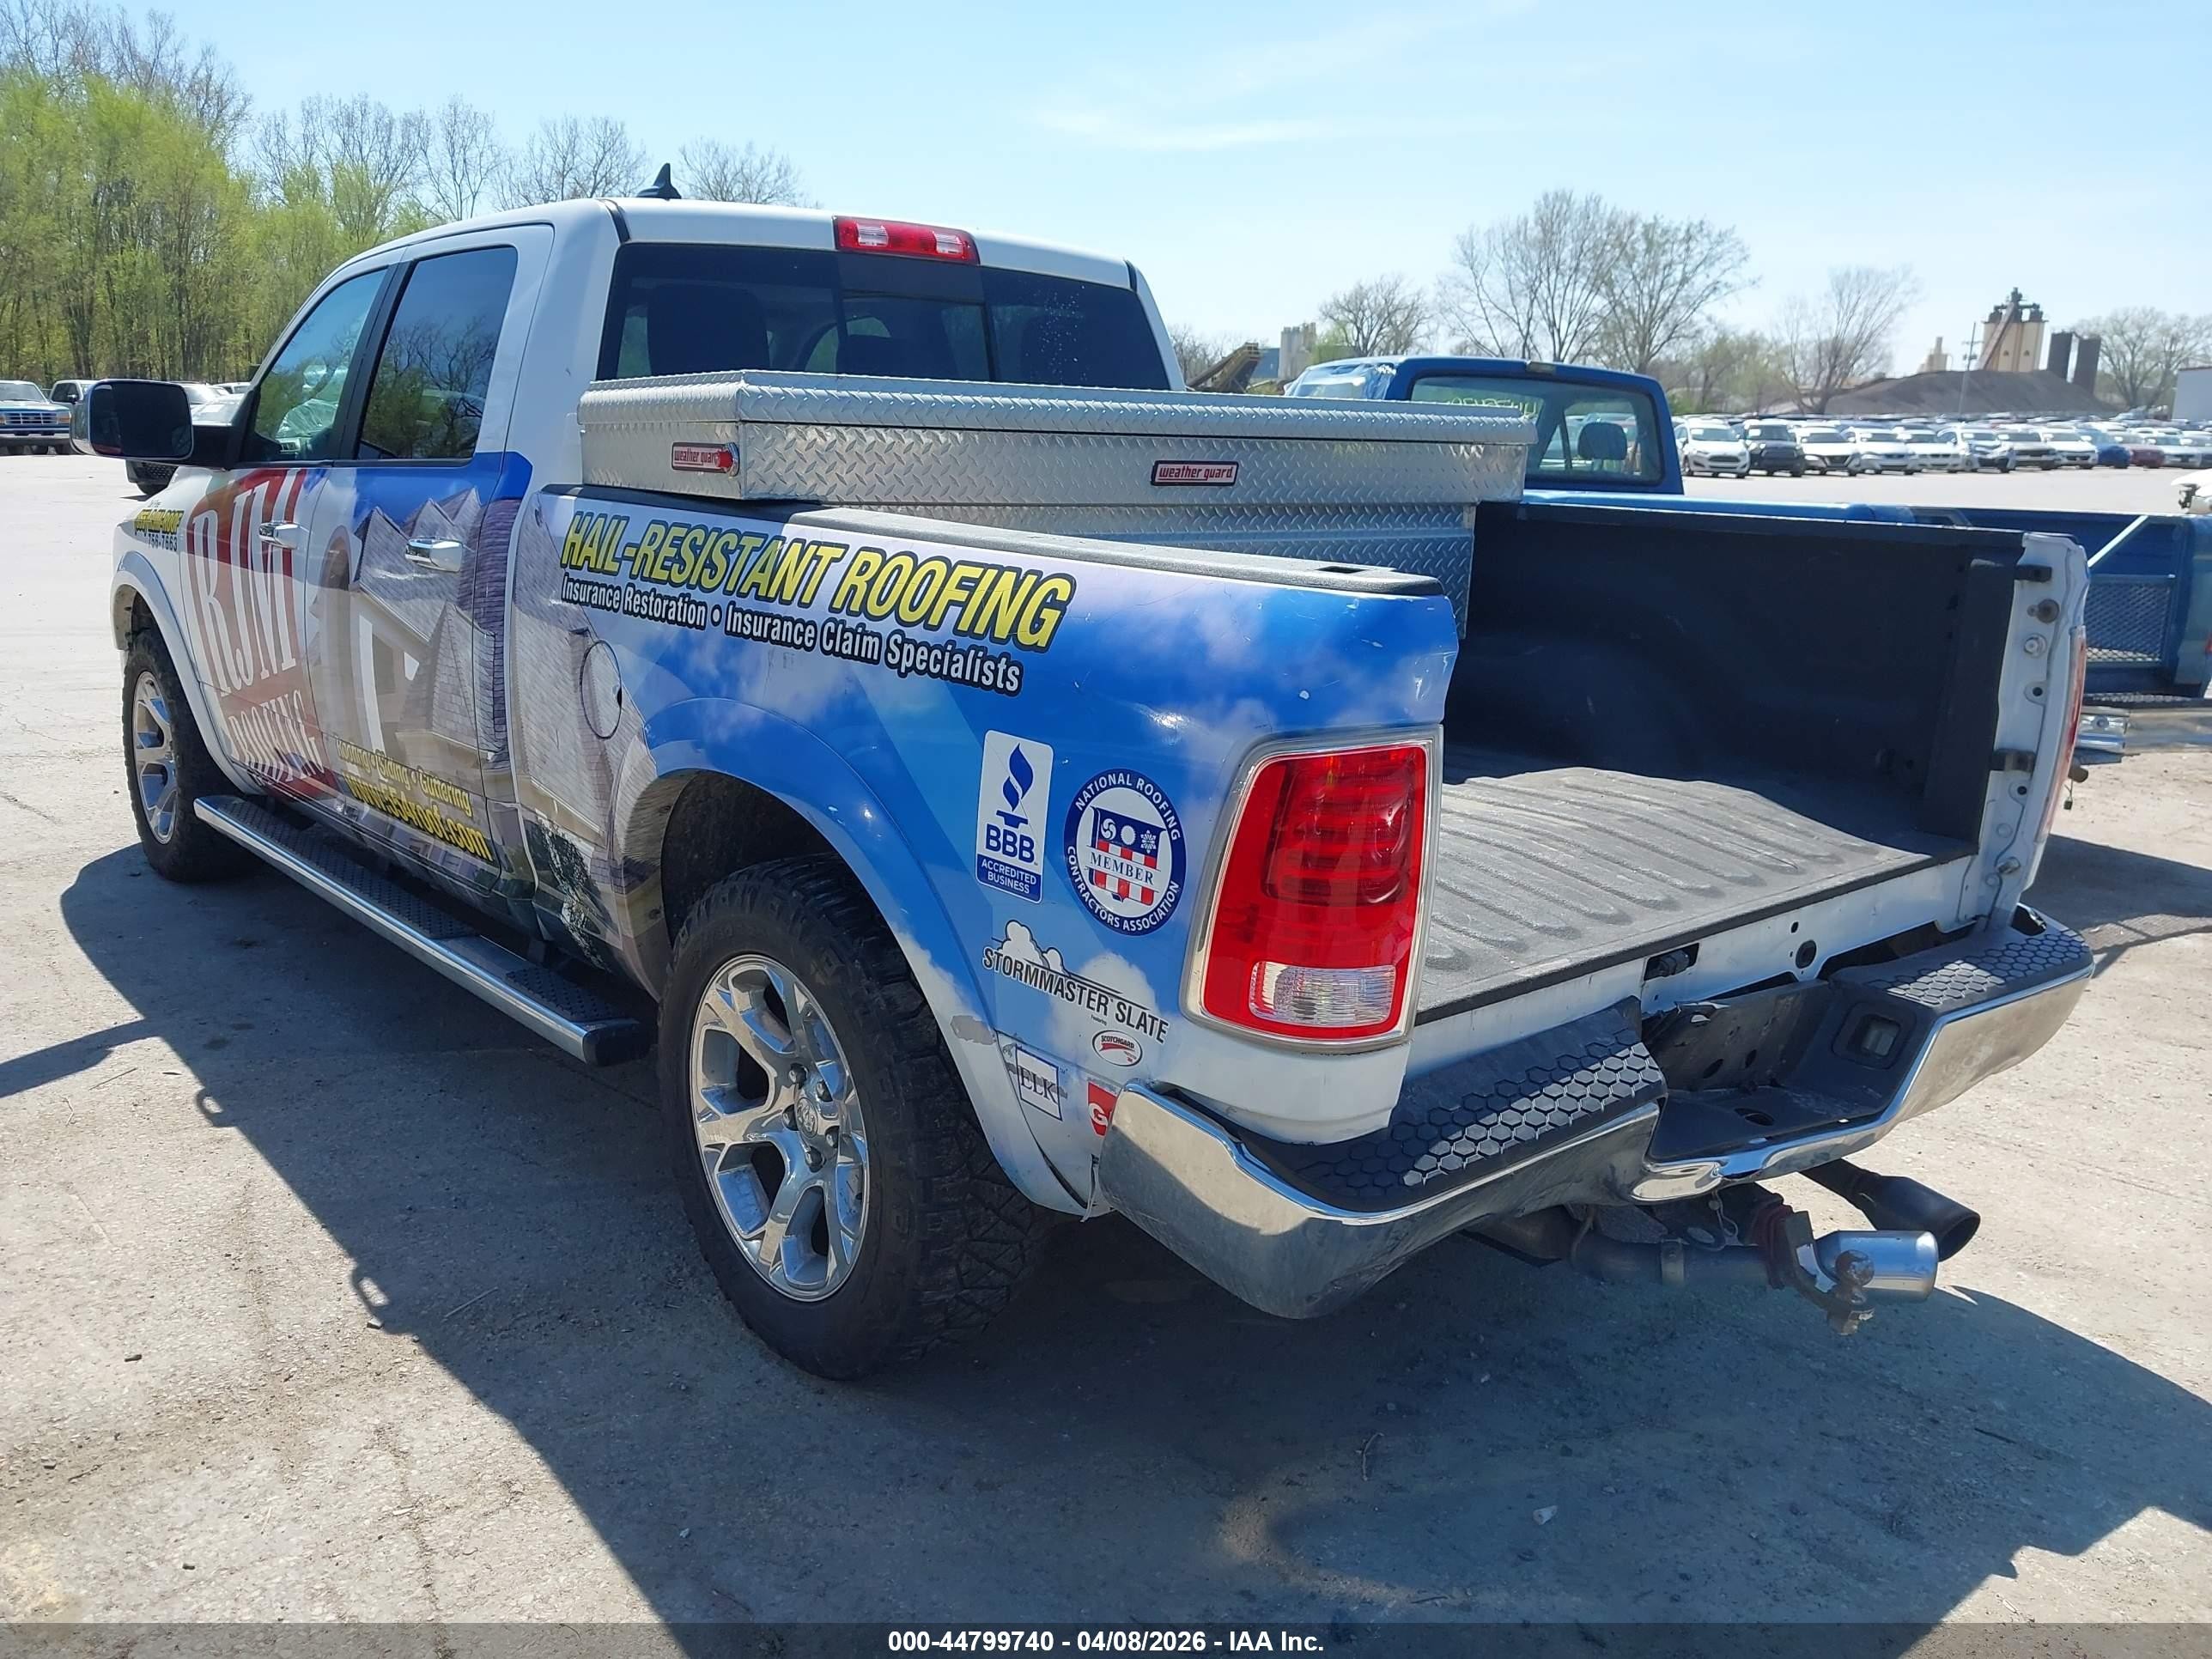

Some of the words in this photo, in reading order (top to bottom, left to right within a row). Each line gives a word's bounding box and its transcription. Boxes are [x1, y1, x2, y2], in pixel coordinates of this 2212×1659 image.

[1159, 465, 1202, 477] weather
[1204, 466, 1233, 481] guard
[561, 511, 843, 604] HAIL-RESISTANT
[833, 550, 1075, 648] ROOFING
[562, 574, 620, 608] Insurance
[619, 585, 706, 627] Restoration
[726, 605, 815, 648] Insurance
[822, 625, 880, 662] Claim
[885, 639, 1022, 692] Specialists
[418, 766, 473, 817] Guttering
[1075, 773, 1133, 811] NATIONAL
[1136, 776, 1182, 841] ROOFING
[985, 823, 1036, 864] BBB
[981, 859, 1036, 885] ACCREDITED
[988, 872, 1030, 894] BUSINESS
[1067, 846, 1120, 928] CONTRACTORS
[1122, 880, 1181, 932] ASSOCIATION
[1090, 851, 1154, 885] MEMBER
[983, 947, 1109, 1016] STORMMASTER
[1115, 1001, 1170, 1044] SLATE
[1018, 1066, 1058, 1105] ELK
